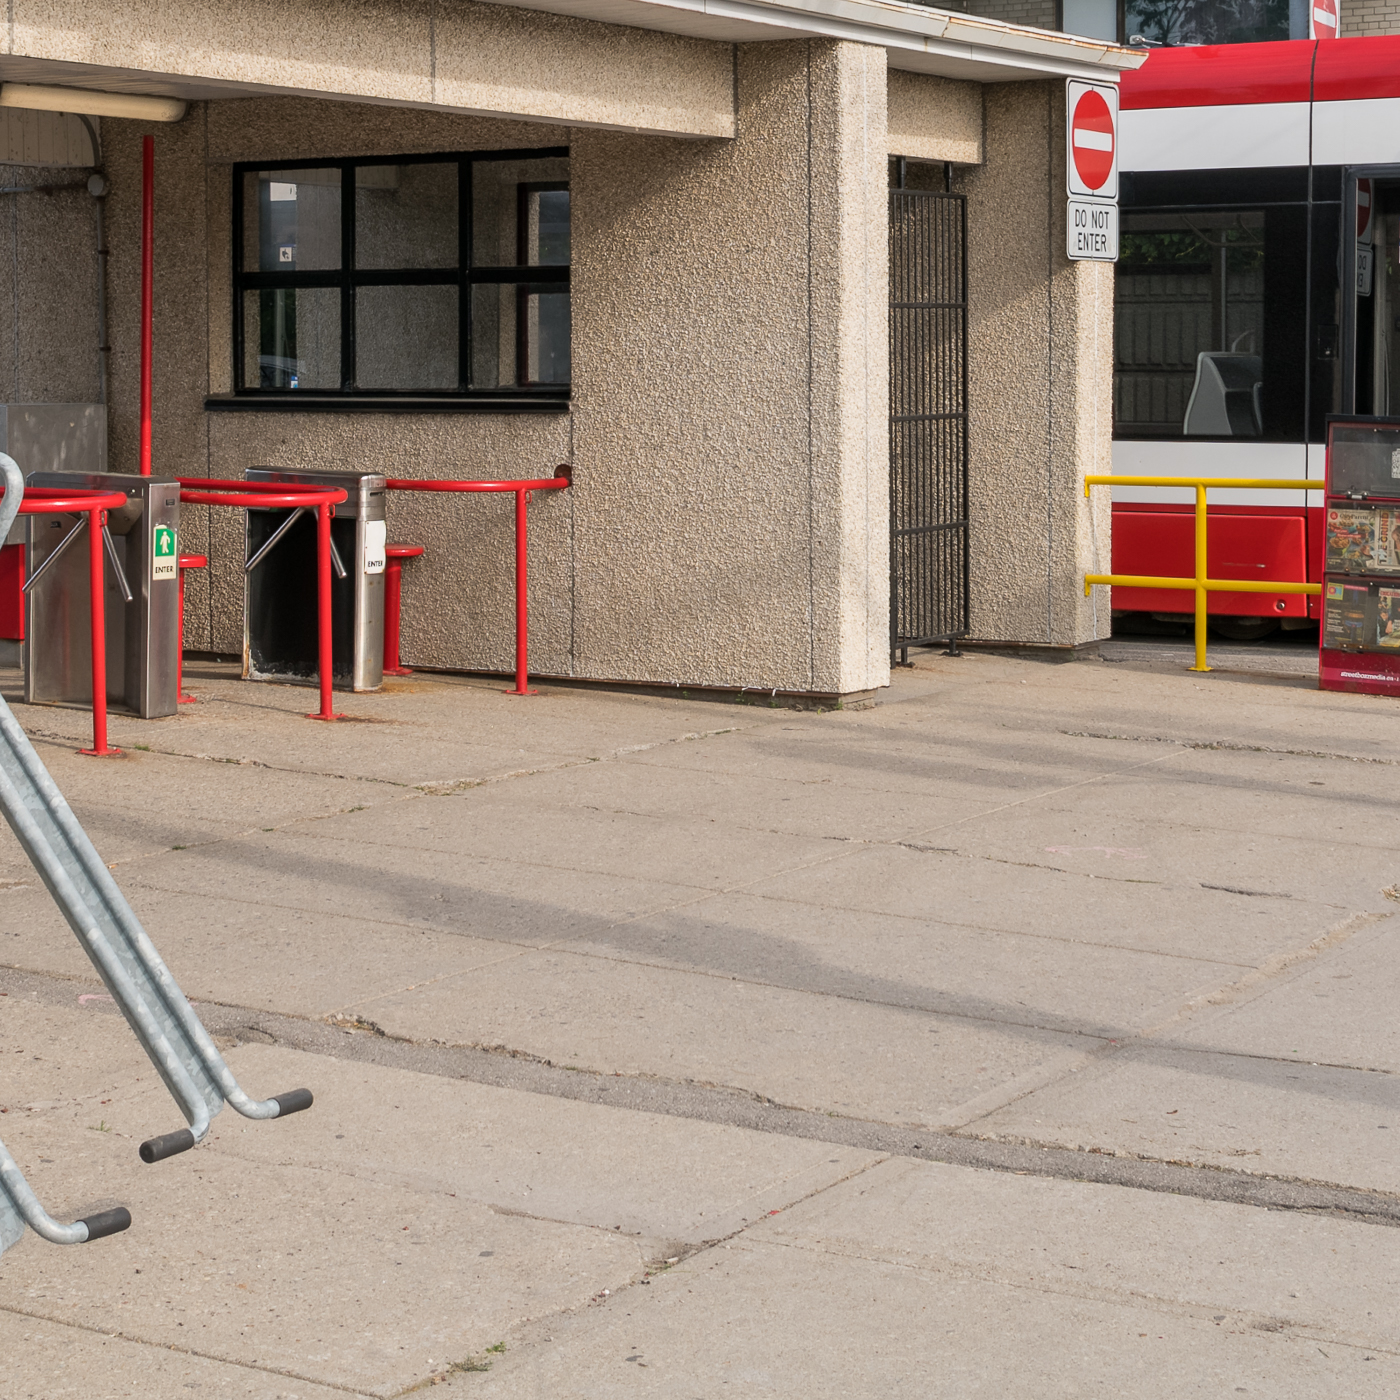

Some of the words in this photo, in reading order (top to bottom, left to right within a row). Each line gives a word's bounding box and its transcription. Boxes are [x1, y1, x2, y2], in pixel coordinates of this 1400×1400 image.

[1075, 209, 1087, 227] DO
[1091, 210, 1109, 230] NOT
[1078, 232, 1107, 252] ENTER
[1380, 512, 1389, 543] GRIND
[155, 565, 174, 575] ENTER
